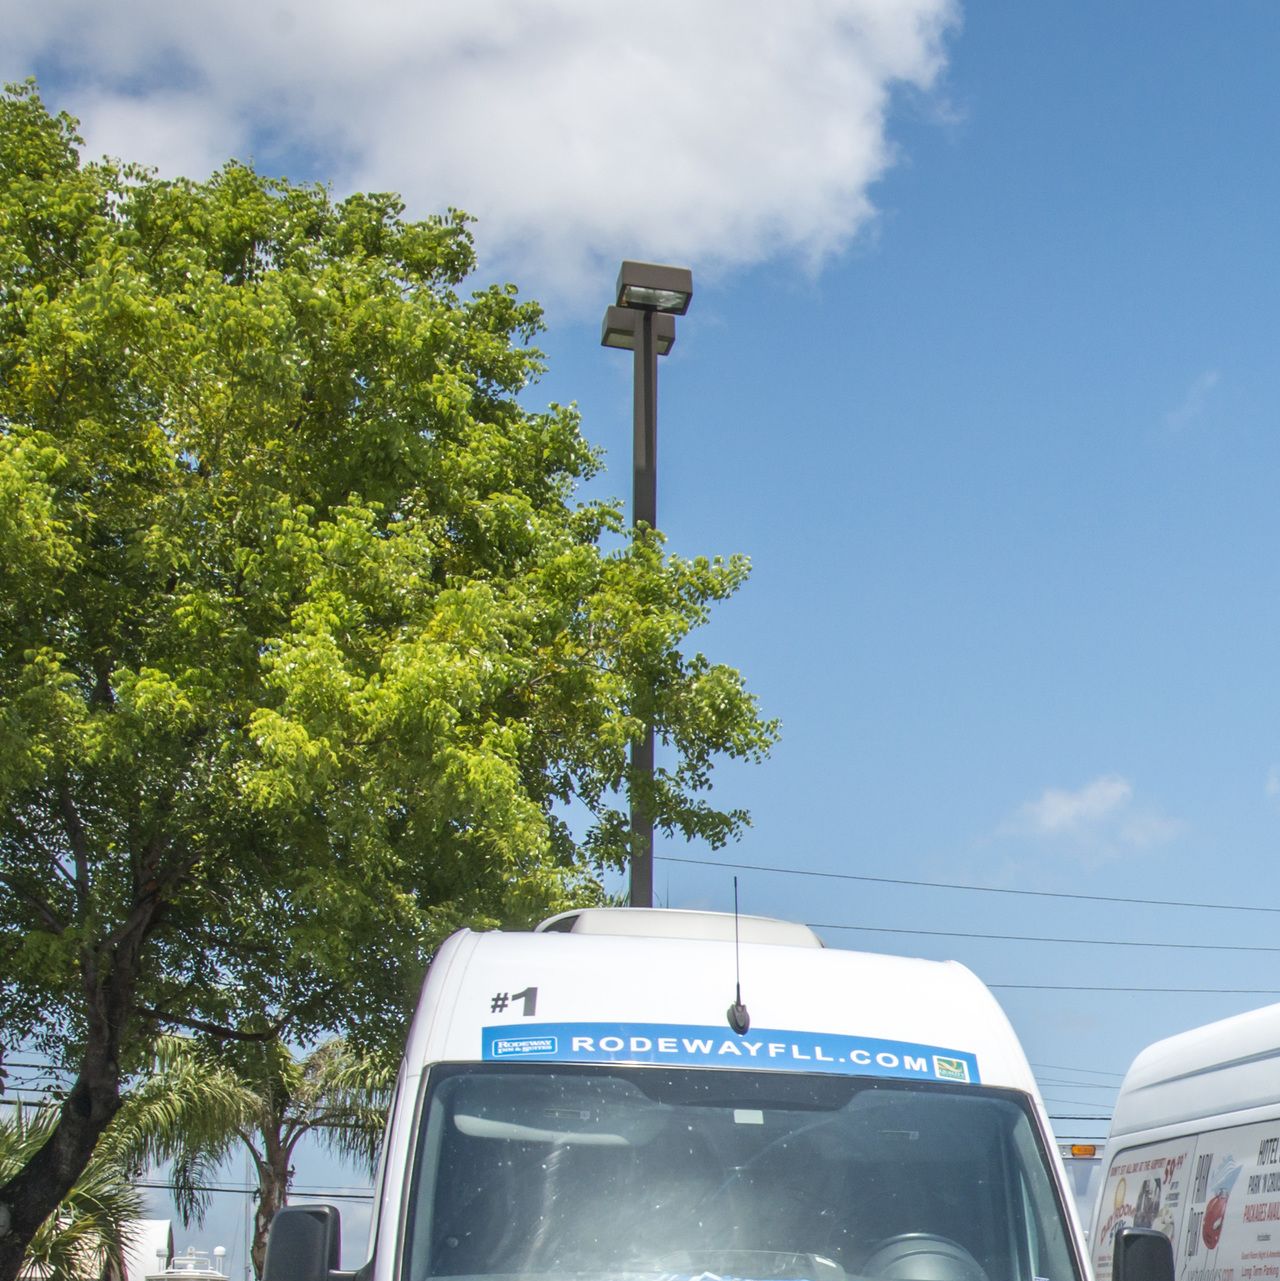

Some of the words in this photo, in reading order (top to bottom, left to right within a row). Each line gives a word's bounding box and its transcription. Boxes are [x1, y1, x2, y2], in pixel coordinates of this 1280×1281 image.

[490, 986, 538, 1017] #1
[571, 1036, 928, 1072] RODEWAYFLL.COM
[1257, 1137, 1279, 1167] HOTEL
